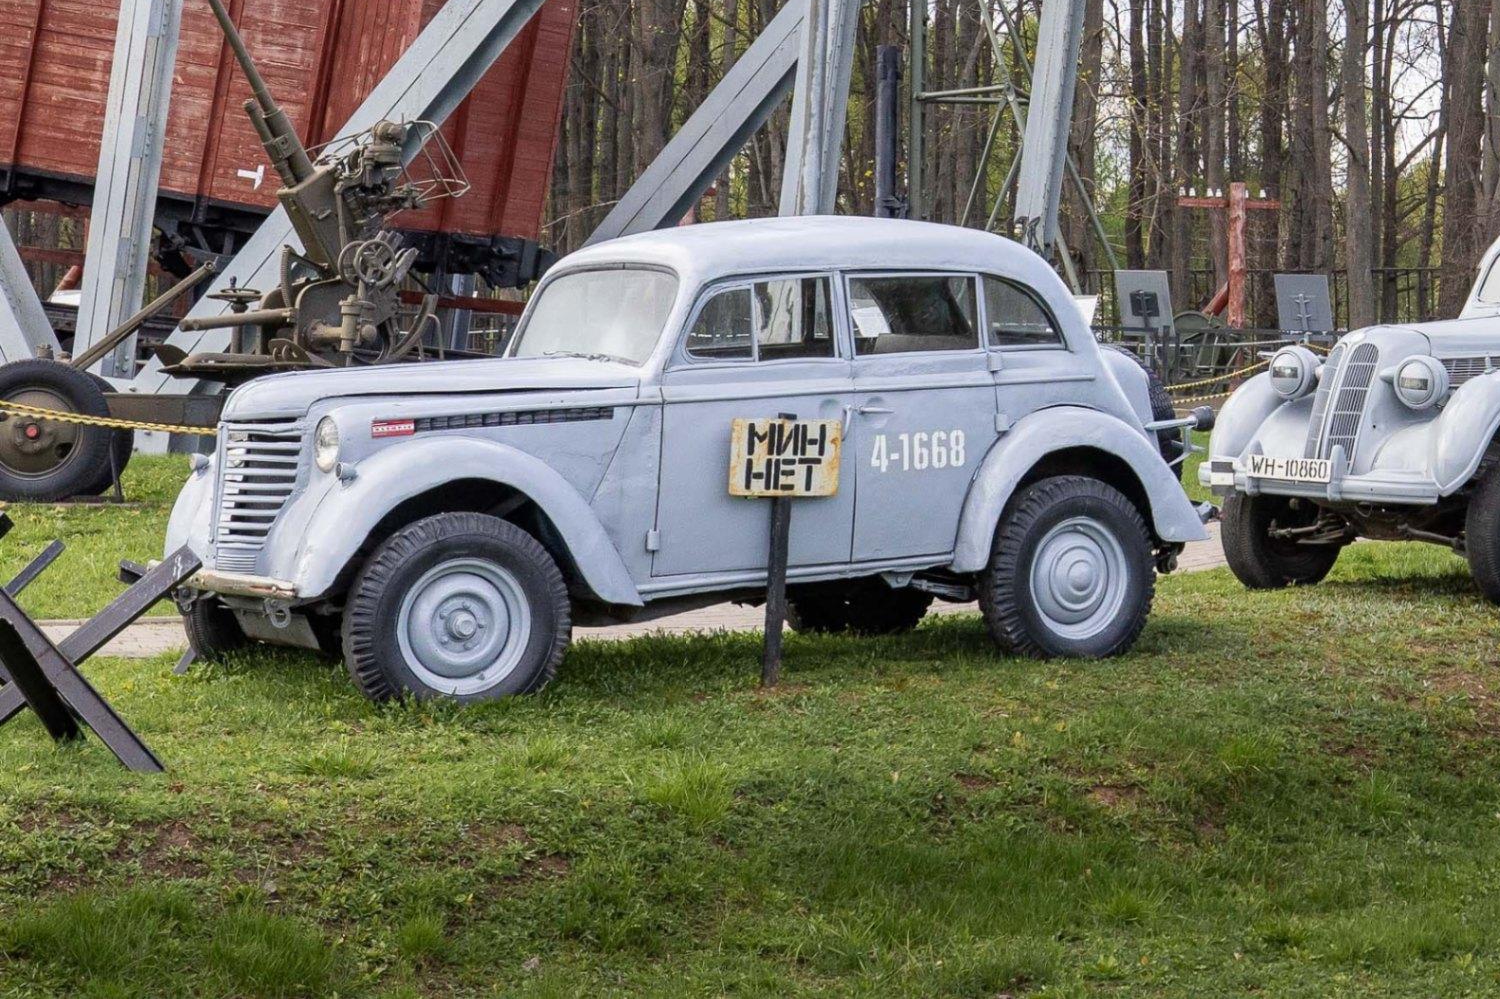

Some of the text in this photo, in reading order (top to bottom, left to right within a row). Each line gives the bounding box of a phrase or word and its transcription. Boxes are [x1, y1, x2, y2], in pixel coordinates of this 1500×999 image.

[747, 422, 826, 456] МИН
[871, 429, 966, 472] 4-1668
[744, 458, 822, 491] НЕТ
[1252, 456, 1327, 479] WH-10860
